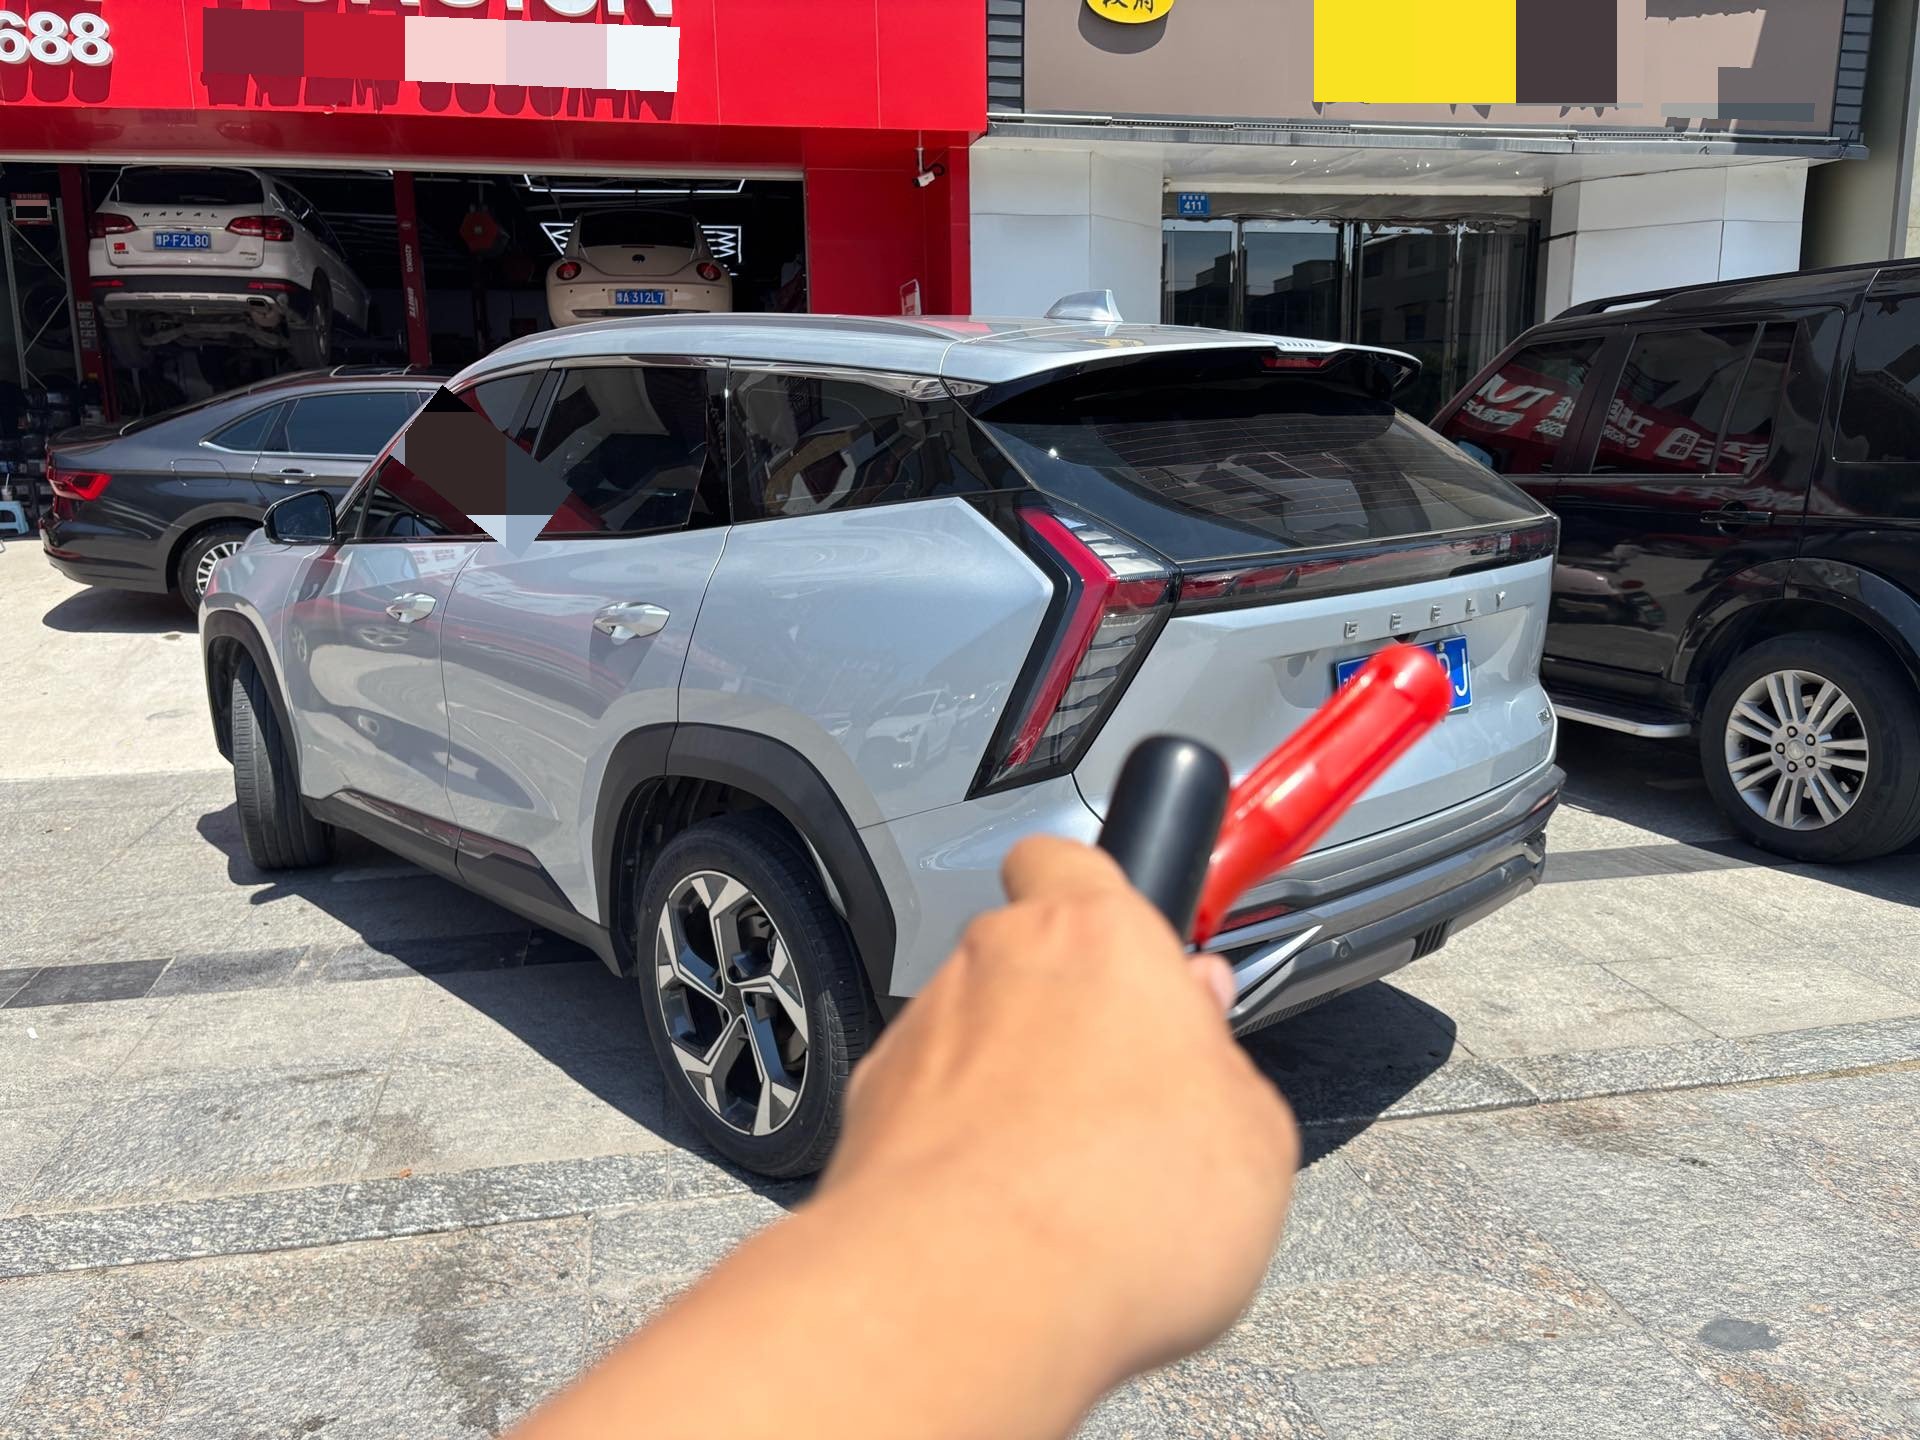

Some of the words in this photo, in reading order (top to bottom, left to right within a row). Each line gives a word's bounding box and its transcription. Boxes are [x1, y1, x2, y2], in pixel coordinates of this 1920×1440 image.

[0, 10, 114, 66] 688
[143, 210, 217, 218] HAVAL
[1184, 201, 1202, 210] 411
[1344, 591, 1506, 639] GEELY
